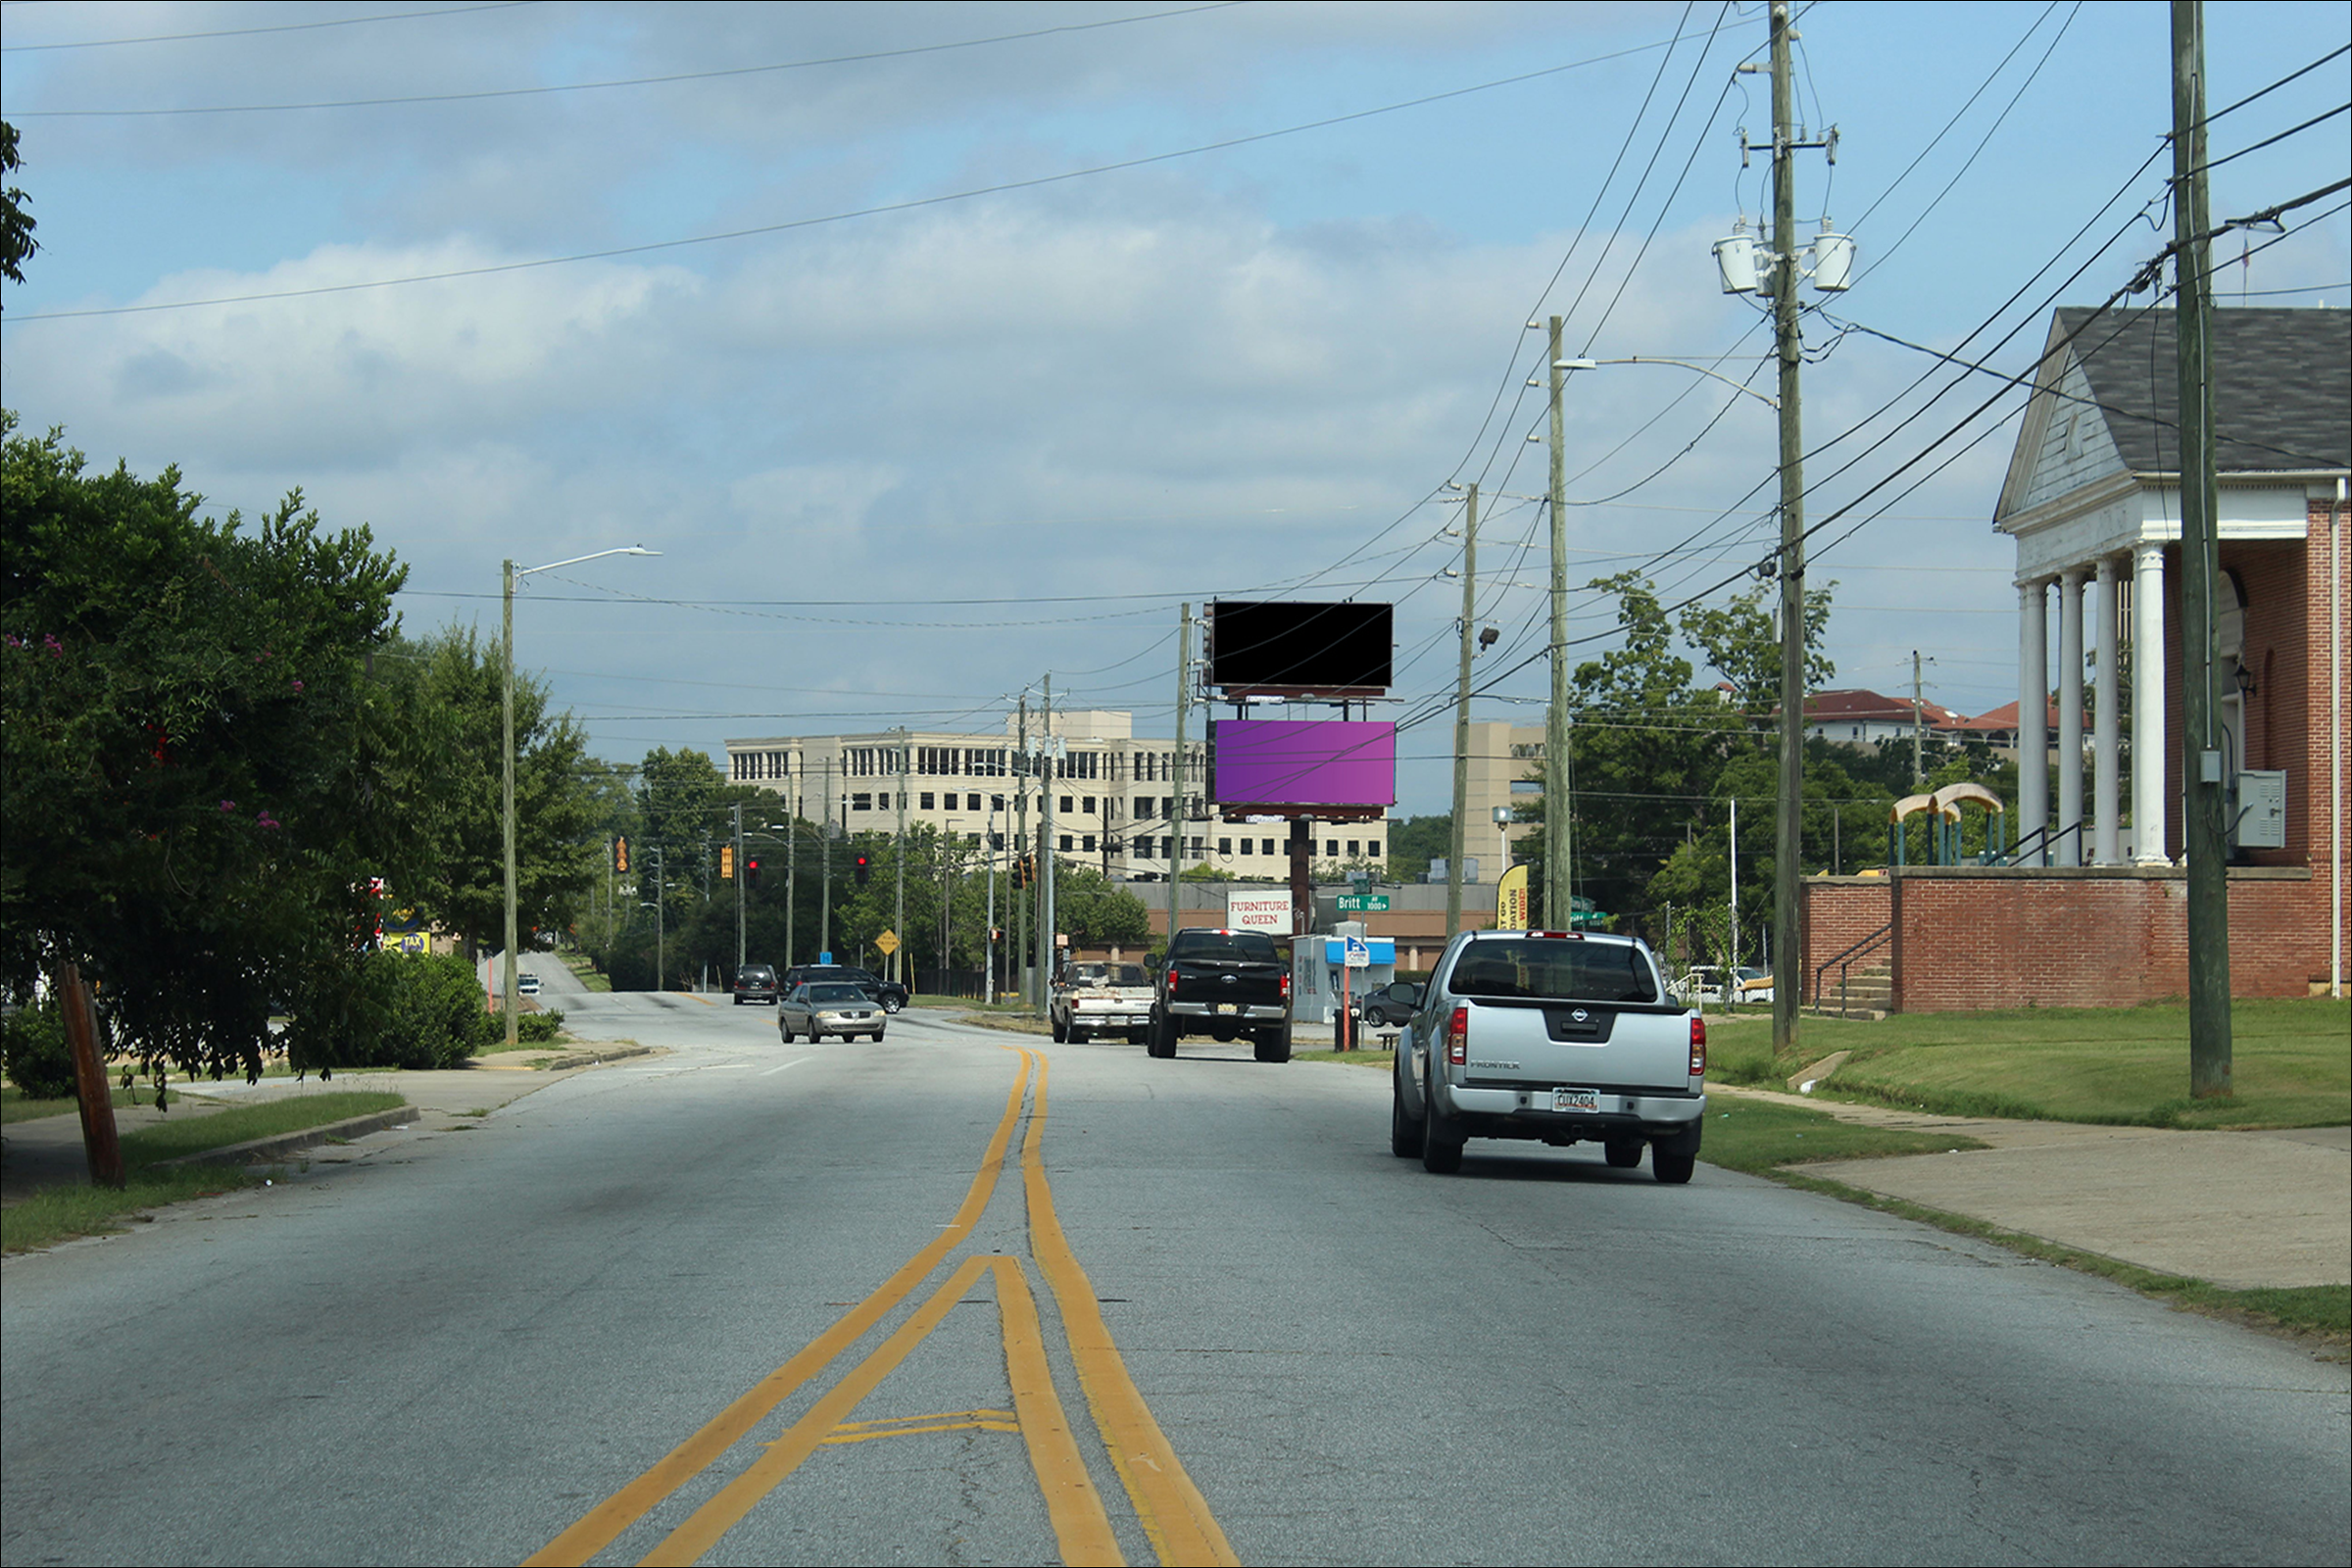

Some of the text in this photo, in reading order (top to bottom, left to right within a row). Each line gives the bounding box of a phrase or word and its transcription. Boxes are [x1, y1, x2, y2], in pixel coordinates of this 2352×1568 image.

[1230, 901, 1289, 911] FURNITURE
[1338, 897, 1361, 909] Britt
[1242, 914, 1278, 925] QUEEN
[405, 936, 421, 947] TAX
[1470, 1059, 1520, 1069] FRONTIER
